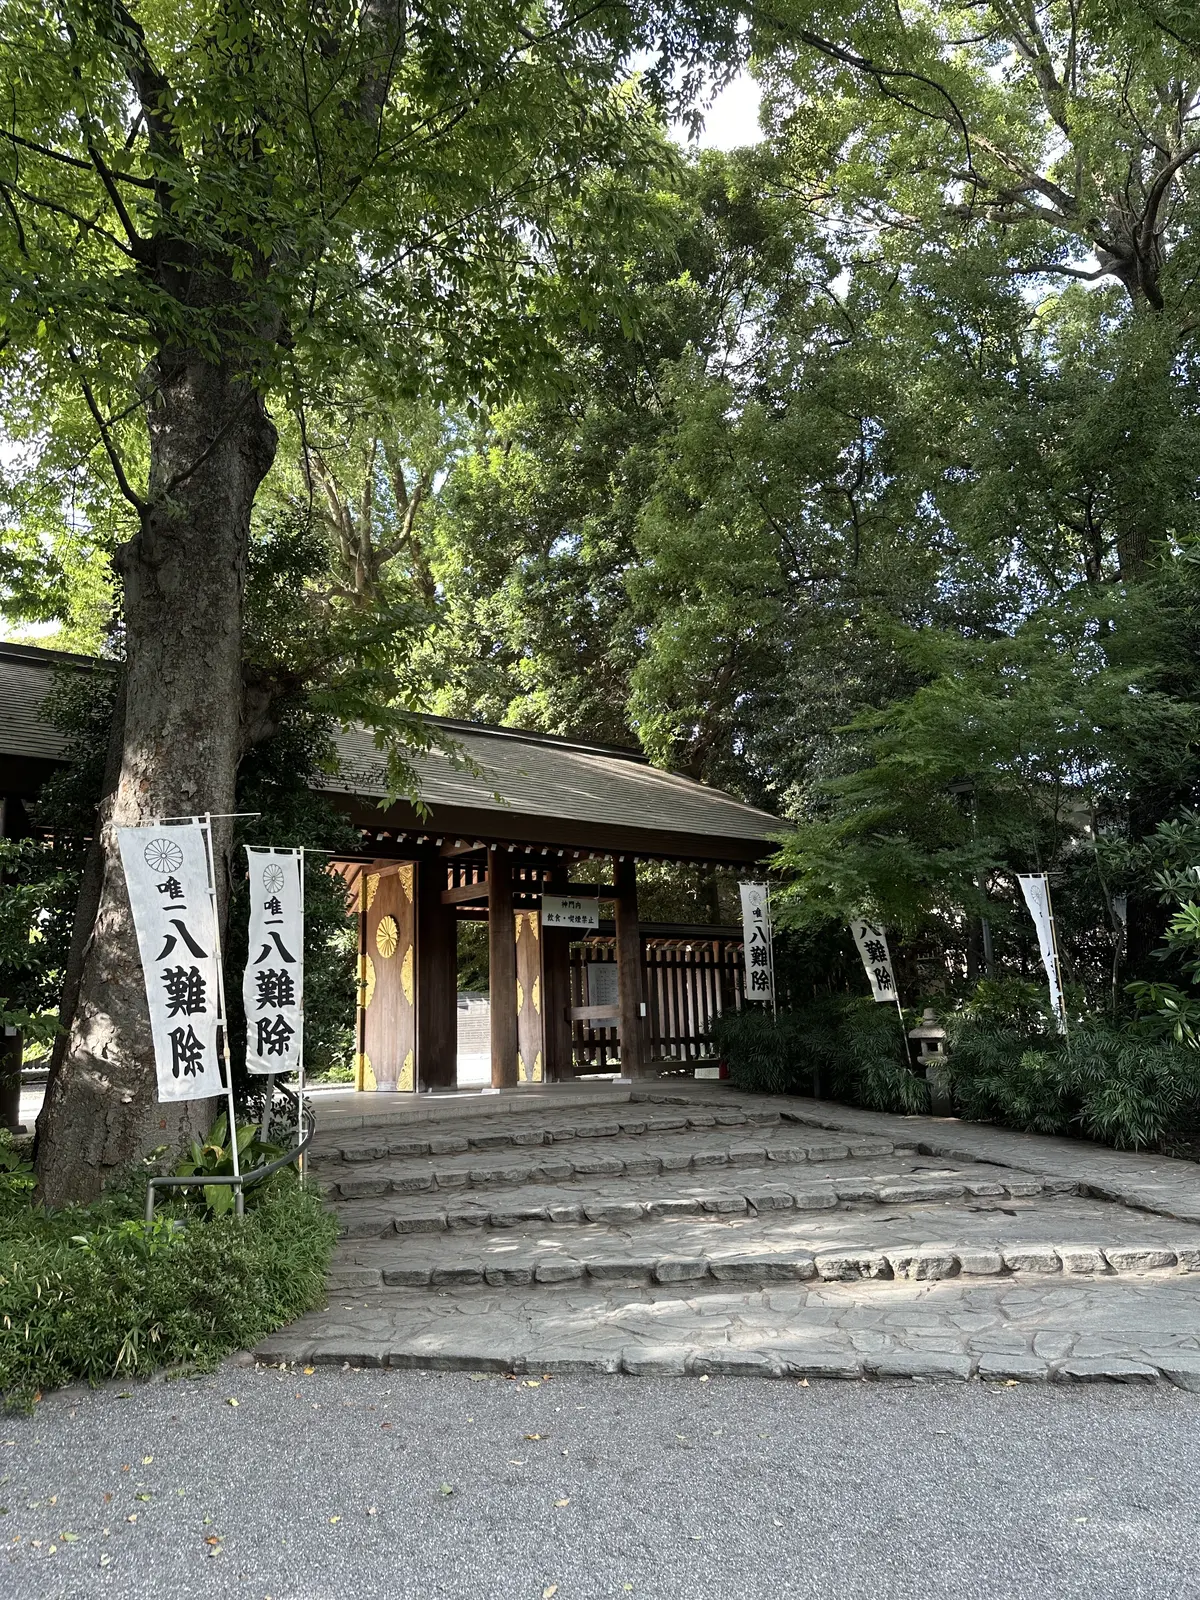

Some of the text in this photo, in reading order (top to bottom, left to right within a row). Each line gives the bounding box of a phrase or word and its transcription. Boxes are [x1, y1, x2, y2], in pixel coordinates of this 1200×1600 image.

[561, 900, 582, 909] 神門内
[749, 907, 770, 992] 唯一八難除
[155, 875, 208, 1078] 唯一八難除
[253, 895, 297, 1056] 唯一八難除
